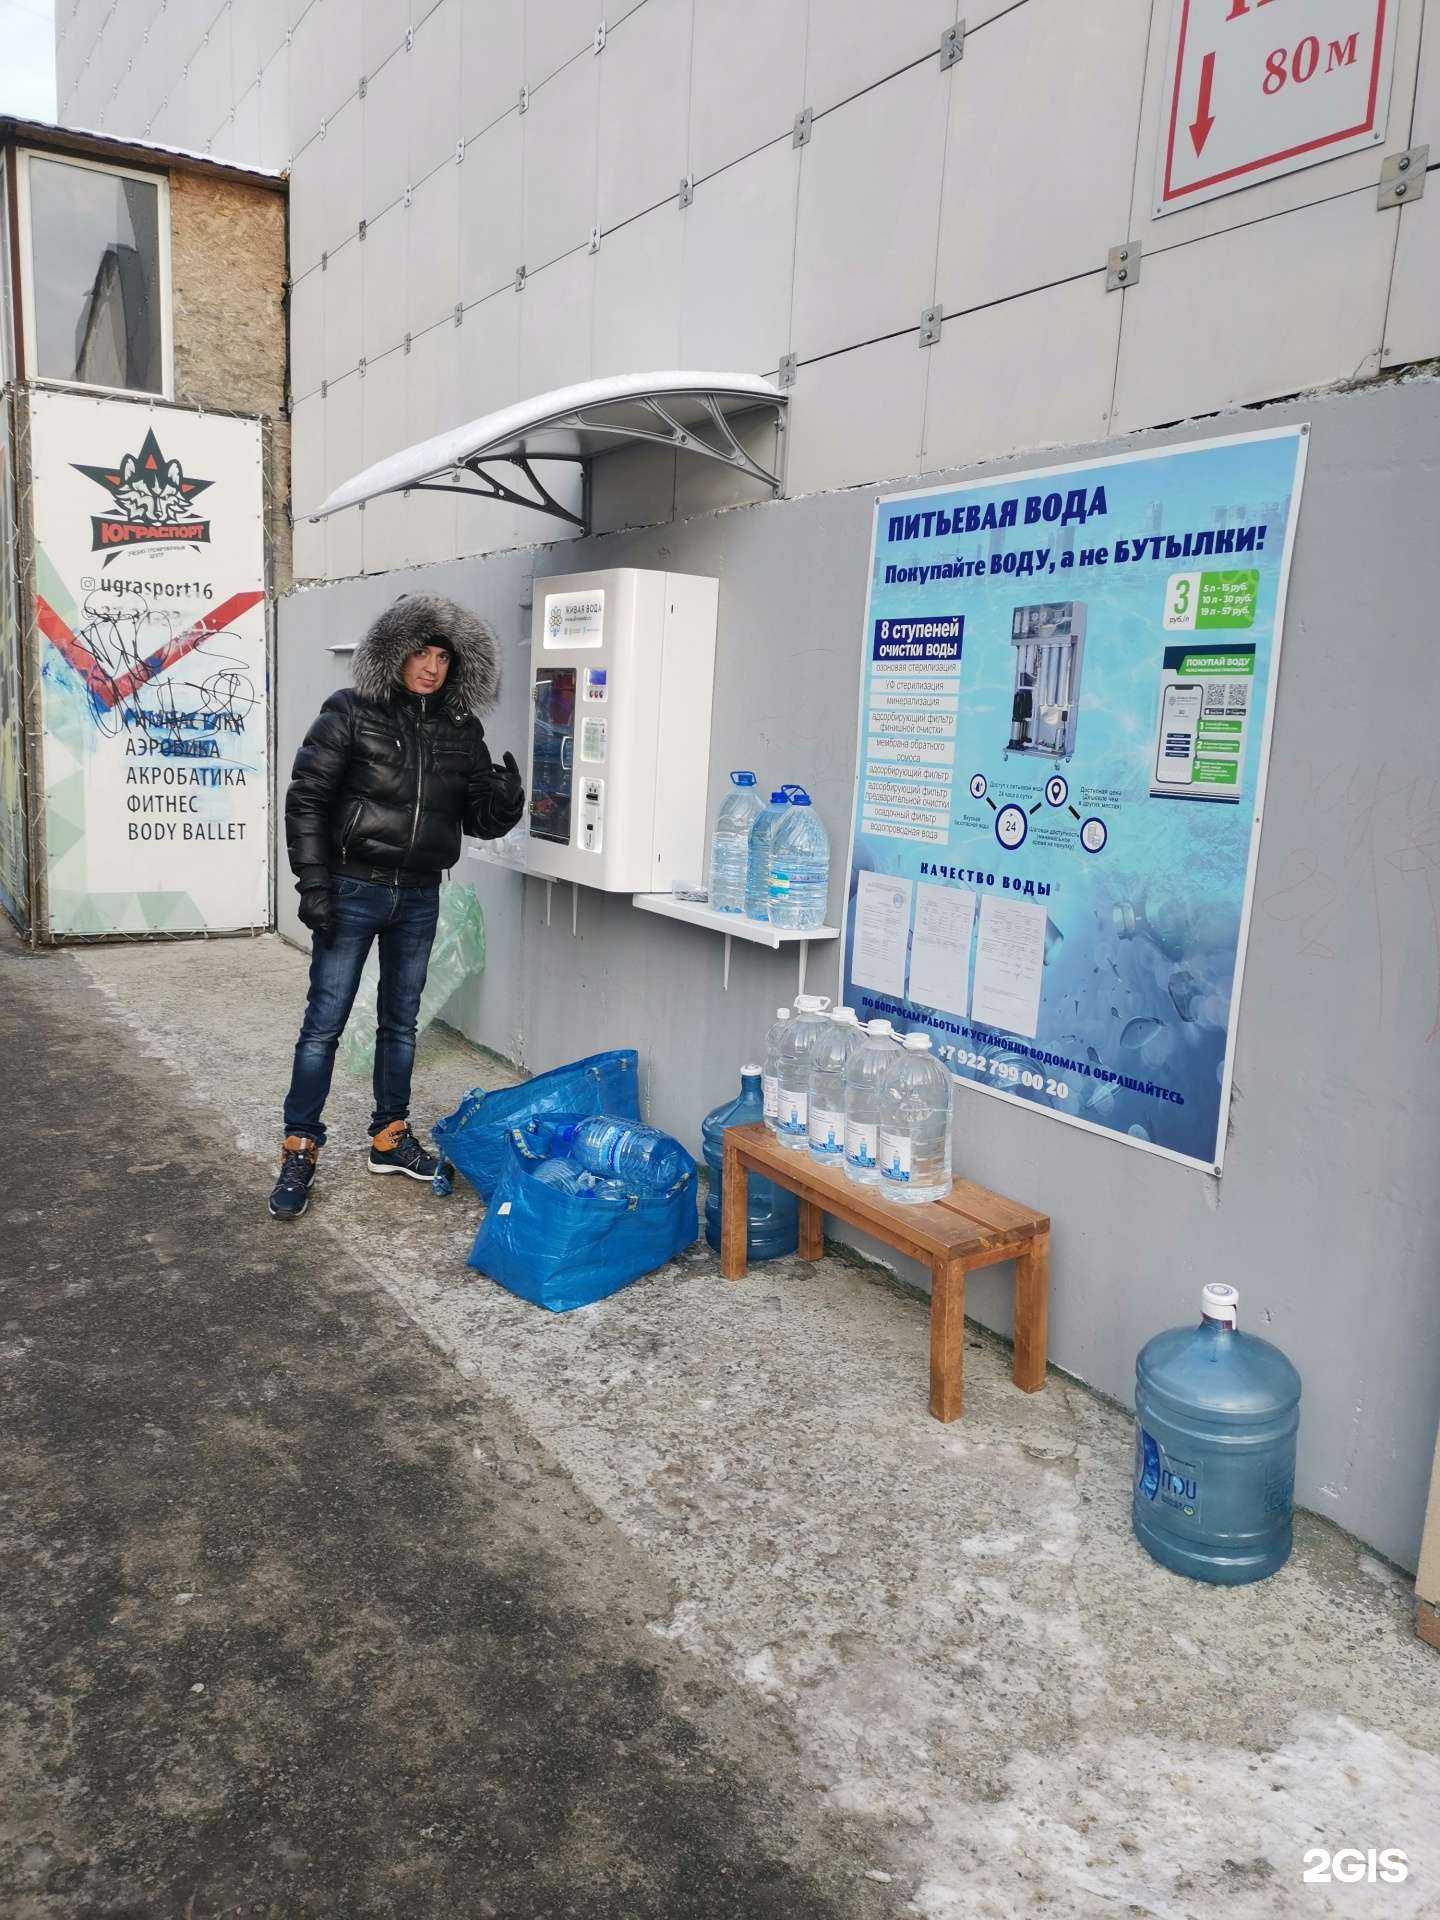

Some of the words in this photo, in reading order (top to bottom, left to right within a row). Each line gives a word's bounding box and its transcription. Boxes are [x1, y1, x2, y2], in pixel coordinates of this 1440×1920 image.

[888, 499, 1018, 542] ПИТЬЕВАЯ
[1023, 486, 1107, 526] ВОДА
[101, 523, 205, 544] ЮГРАСПОРТ
[885, 557, 986, 584] Покупайте
[990, 548, 1056, 576] ВОДУ,
[1060, 549, 1074, 569] а
[1078, 544, 1108, 566] не
[1114, 525, 1268, 564] БУТЫЛКИ!
[101, 578, 213, 601] ugrasport16
[1173, 579, 1191, 615] 3
[1202, 584, 1209, 593] 5
[1221, 583, 1231, 592] 15
[1202, 596, 1211, 604] 10
[1222, 595, 1233, 603] 30
[1221, 606, 1231, 615] 57
[880, 620, 889, 639] 8
[892, 617, 959, 643] ступеней
[879, 643, 923, 657] очистки
[925, 643, 957, 659] воды
[876, 663, 906, 672] озоновая
[908, 663, 956, 674] стерилизация
[896, 681, 944, 691] стерилизация
[886, 697, 940, 706] минерализация
[126, 738, 221, 758] АЭРОБИКА
[126, 766, 247, 786] АКРОБАТИКА
[126, 794, 200, 813] ФИТНЕС
[127, 822, 177, 841] BODY
[183, 822, 247, 841] BALLET
[1005, 821, 1016, 832] 24
[920, 862, 995, 887] КАЧЕСТВО
[1002, 875, 1051, 897] ВОДЫ
[920, 1012, 960, 1035] РАБОТЫ
[960, 1025, 969, 1037] И
[969, 1028, 1029, 1058] УСТАНОВКИ
[1028, 1046, 1092, 1078] ВОДОМАТА
[957, 1047, 987, 1074] 922
[989, 1056, 1019, 1083] 799
[1021, 1070, 1045, 1091] 00
[1046, 1076, 1070, 1099] 20
